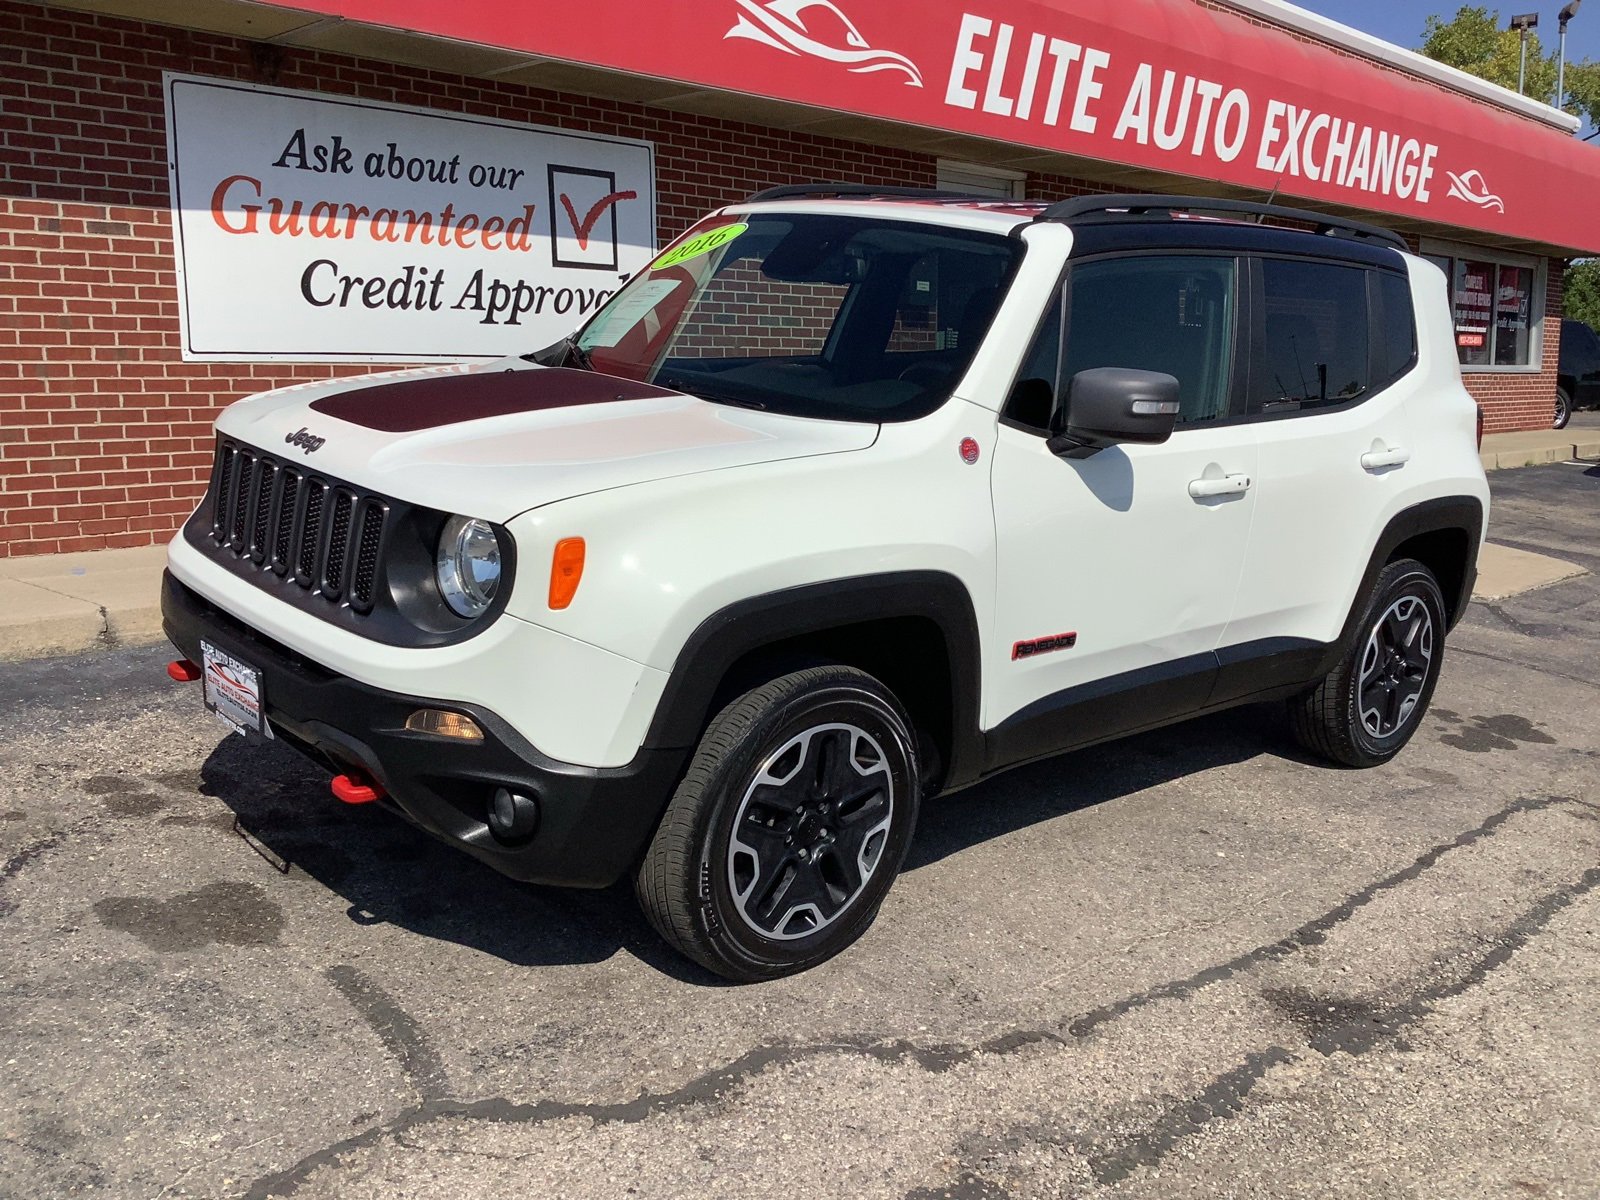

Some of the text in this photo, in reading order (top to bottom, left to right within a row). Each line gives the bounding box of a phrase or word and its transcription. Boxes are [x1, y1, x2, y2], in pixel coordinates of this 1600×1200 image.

[945, 12, 1440, 204] ELITE AUTO EXCHANGE
[272, 128, 526, 192] Ask about our
[210, 175, 535, 253] Guaranteed
[664, 227, 732, 265] 2016
[300, 259, 446, 313] Credit
[285, 427, 326, 455] Jeep
[1013, 632, 1077, 661] RENEGADE
